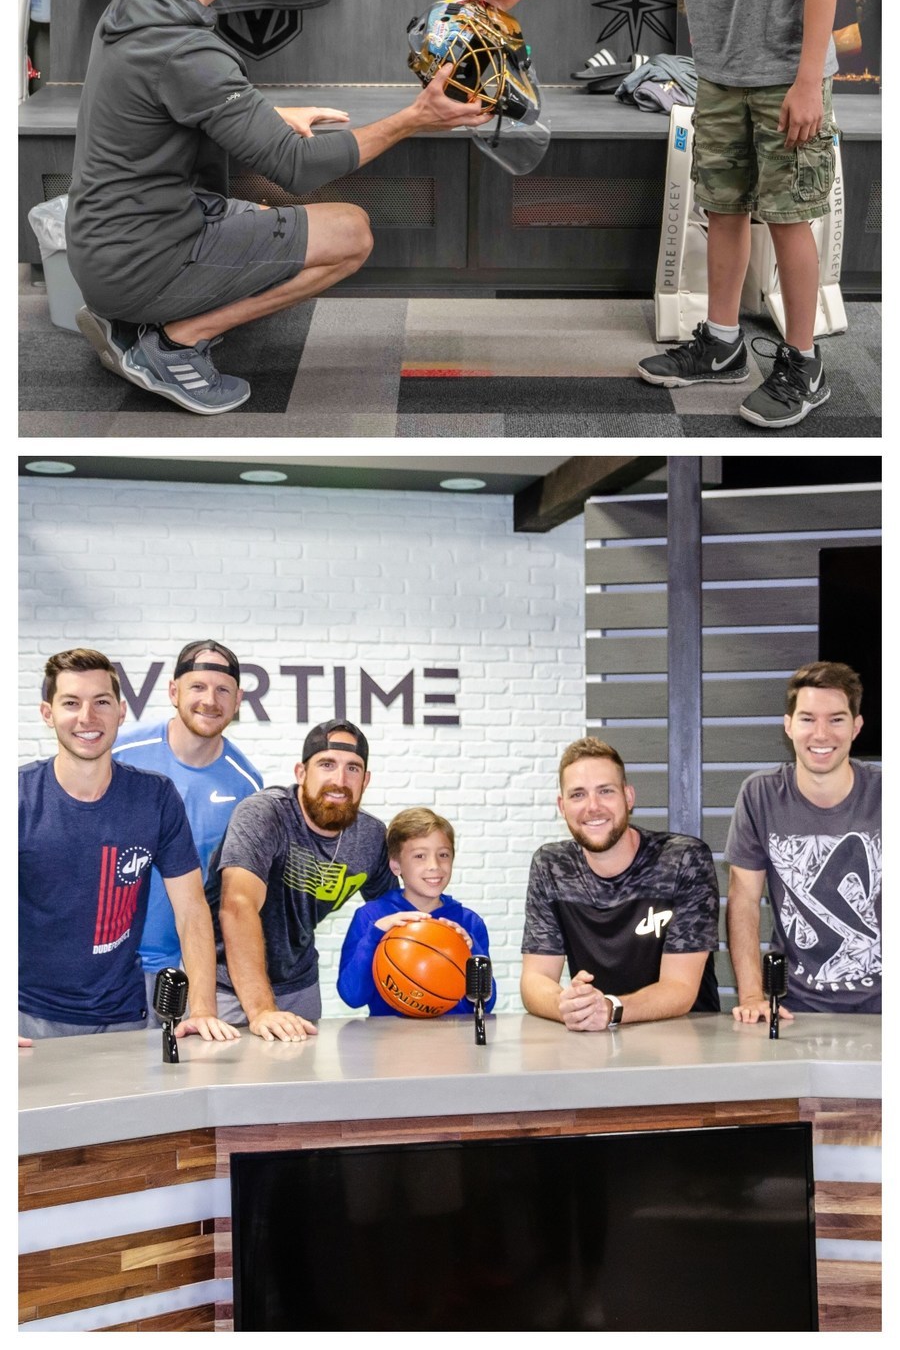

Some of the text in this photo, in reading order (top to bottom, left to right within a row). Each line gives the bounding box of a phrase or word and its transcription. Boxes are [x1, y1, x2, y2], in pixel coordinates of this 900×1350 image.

[664, 182, 681, 287] PURE HOCKEY
[831, 176, 843, 278] PURE HOCKEY
[381, 974, 442, 1015] SPALDING
